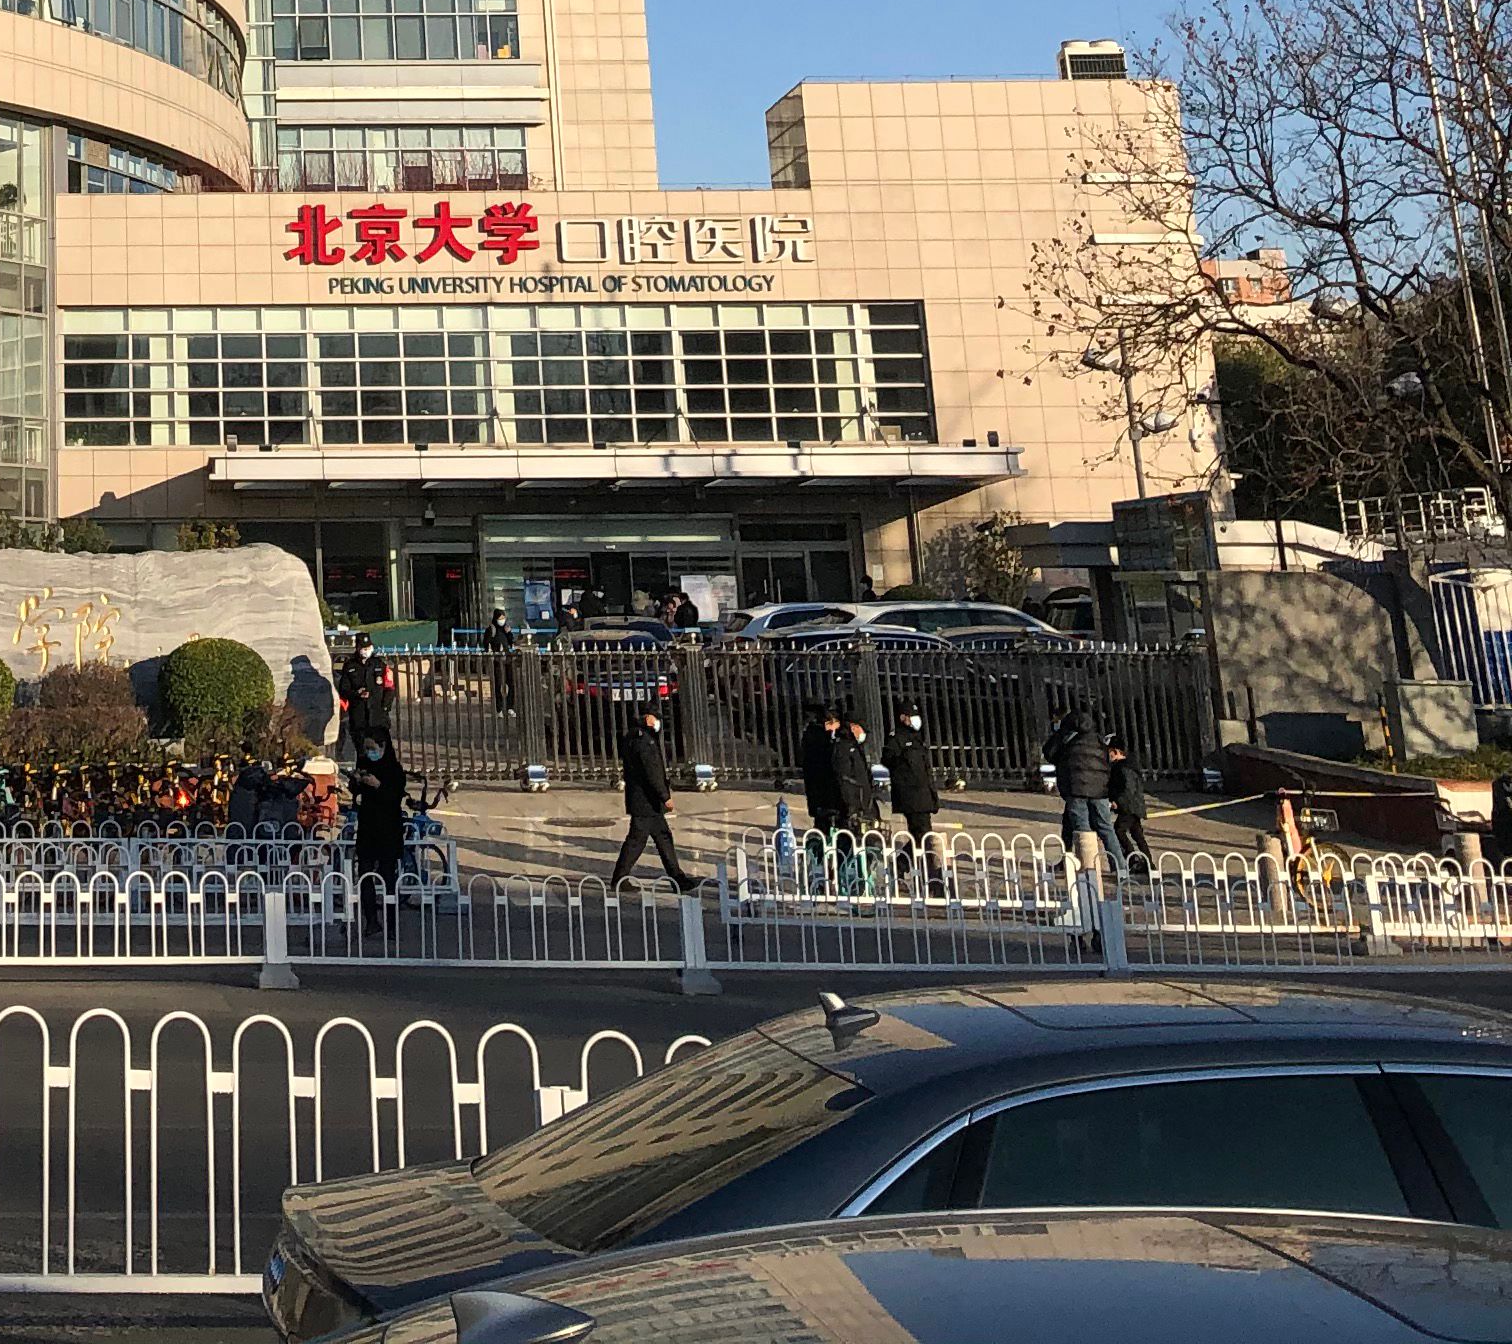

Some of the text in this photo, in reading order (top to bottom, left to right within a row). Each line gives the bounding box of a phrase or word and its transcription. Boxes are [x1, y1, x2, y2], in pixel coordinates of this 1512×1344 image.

[328, 274, 775, 296] PEKING UNIVERSITY HOSPITAL OF STOMATOLOGY
